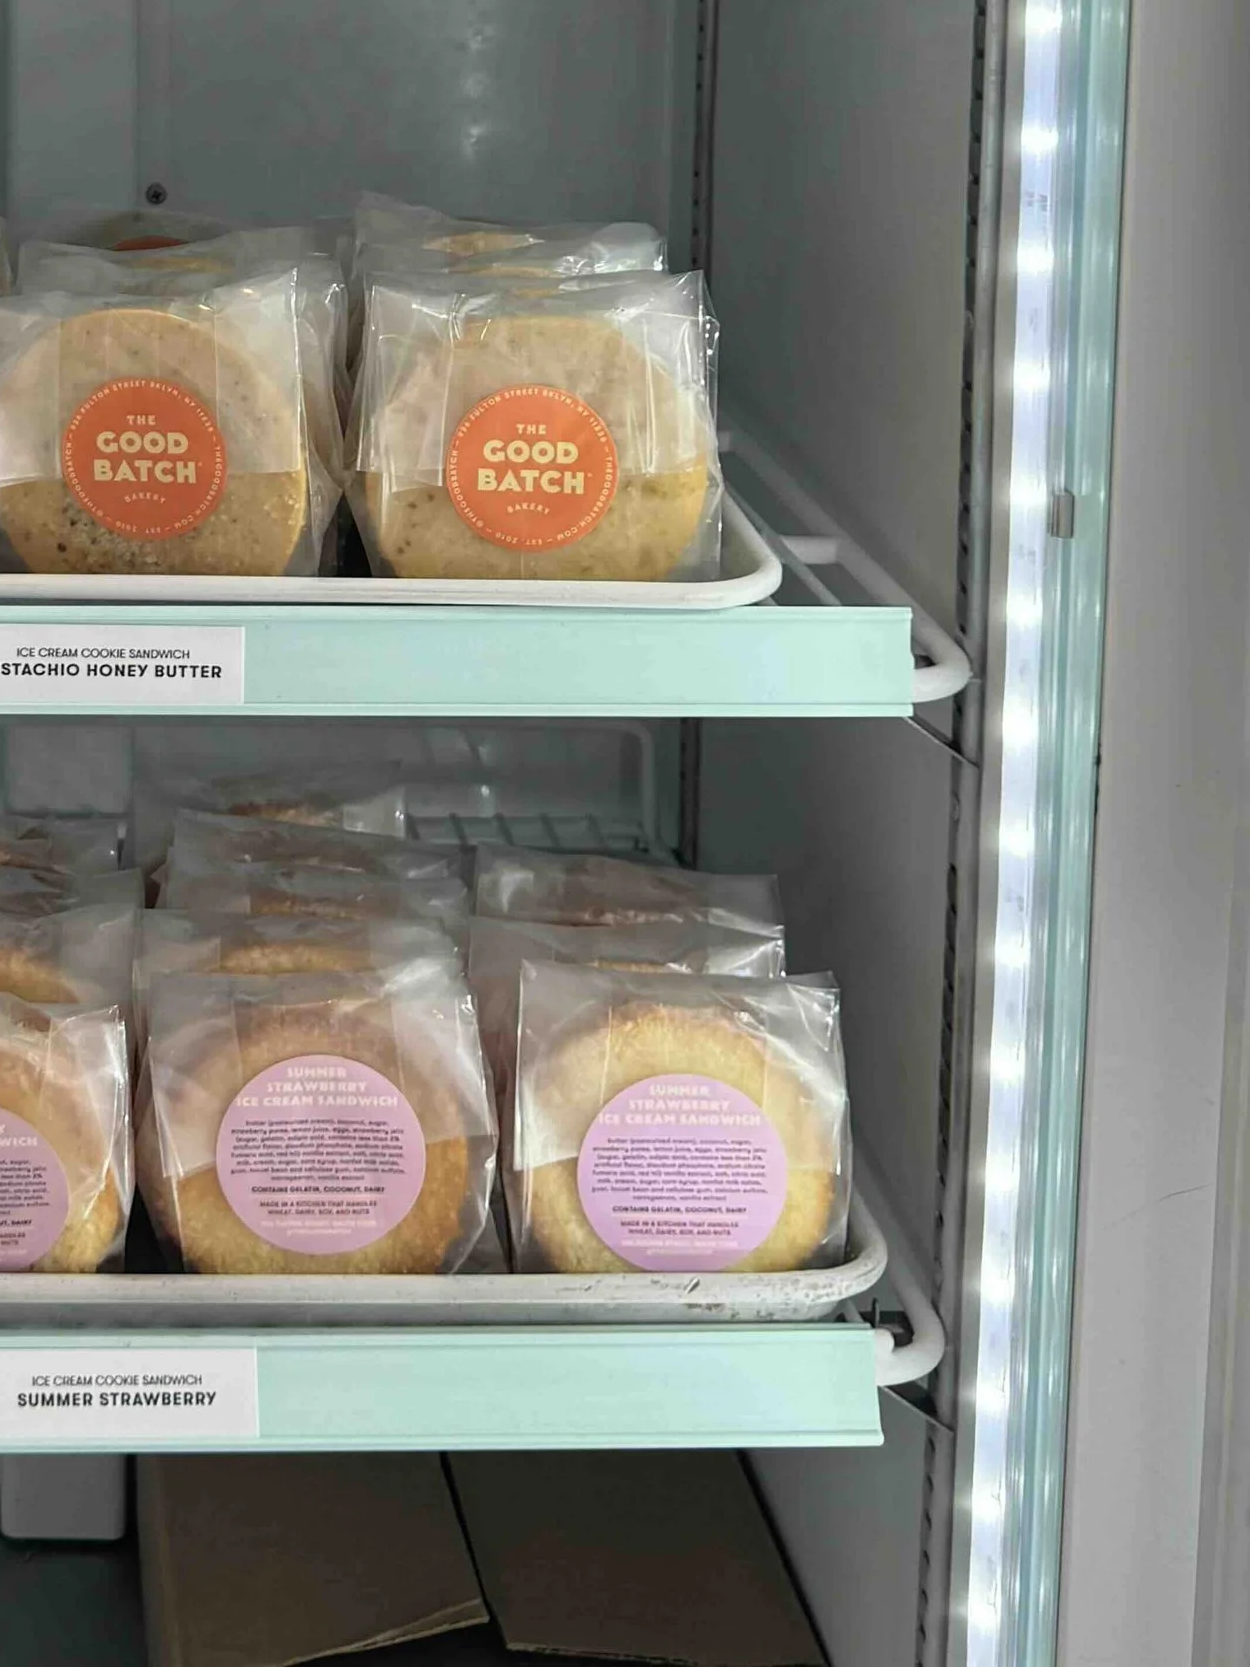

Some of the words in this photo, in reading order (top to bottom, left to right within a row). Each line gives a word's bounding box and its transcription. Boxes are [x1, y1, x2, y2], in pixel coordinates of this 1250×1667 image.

[504, 388, 539, 398] STREET
[127, 415, 156, 425] THE
[517, 424, 546, 434] THE
[96, 431, 188, 454] GOOD
[483, 439, 578, 464] GOOD
[93, 459, 197, 484] BATCH
[477, 468, 584, 494] BATCH
[123, 493, 166, 504] BAKERY
[507, 503, 550, 514] BAKERY
[17, 648, 35, 657] ICE
[38, 648, 78, 658] CREAM
[81, 648, 126, 658] COOKIE
[129, 649, 190, 659] SANDWICH
[87, 664, 148, 677] HONEY
[155, 665, 222, 678] BUTTER
[287, 1067, 347, 1078] SUMMER
[267, 1082, 368, 1093] STRAWBERRY
[650, 1085, 710, 1096] SUMMER
[237, 1097, 258, 1106] ICE
[263, 1097, 313, 1106] CREAM
[318, 1096, 397, 1107] SANDWICH
[629, 1100, 732, 1111] STRAWBERRY
[599, 1114, 619, 1125] ICE
[626, 1113, 675, 1125] CREAM
[681, 1114, 761, 1126] SANDWICH
[32, 1376, 50, 1386] ICE
[53, 1376, 92, 1386] CREAM
[96, 1375, 139, 1386] COOKIE
[142, 1375, 202, 1386] SANDWICH
[18, 1393, 92, 1407] SUMMER
[99, 1391, 216, 1406] STRAWBERRY
